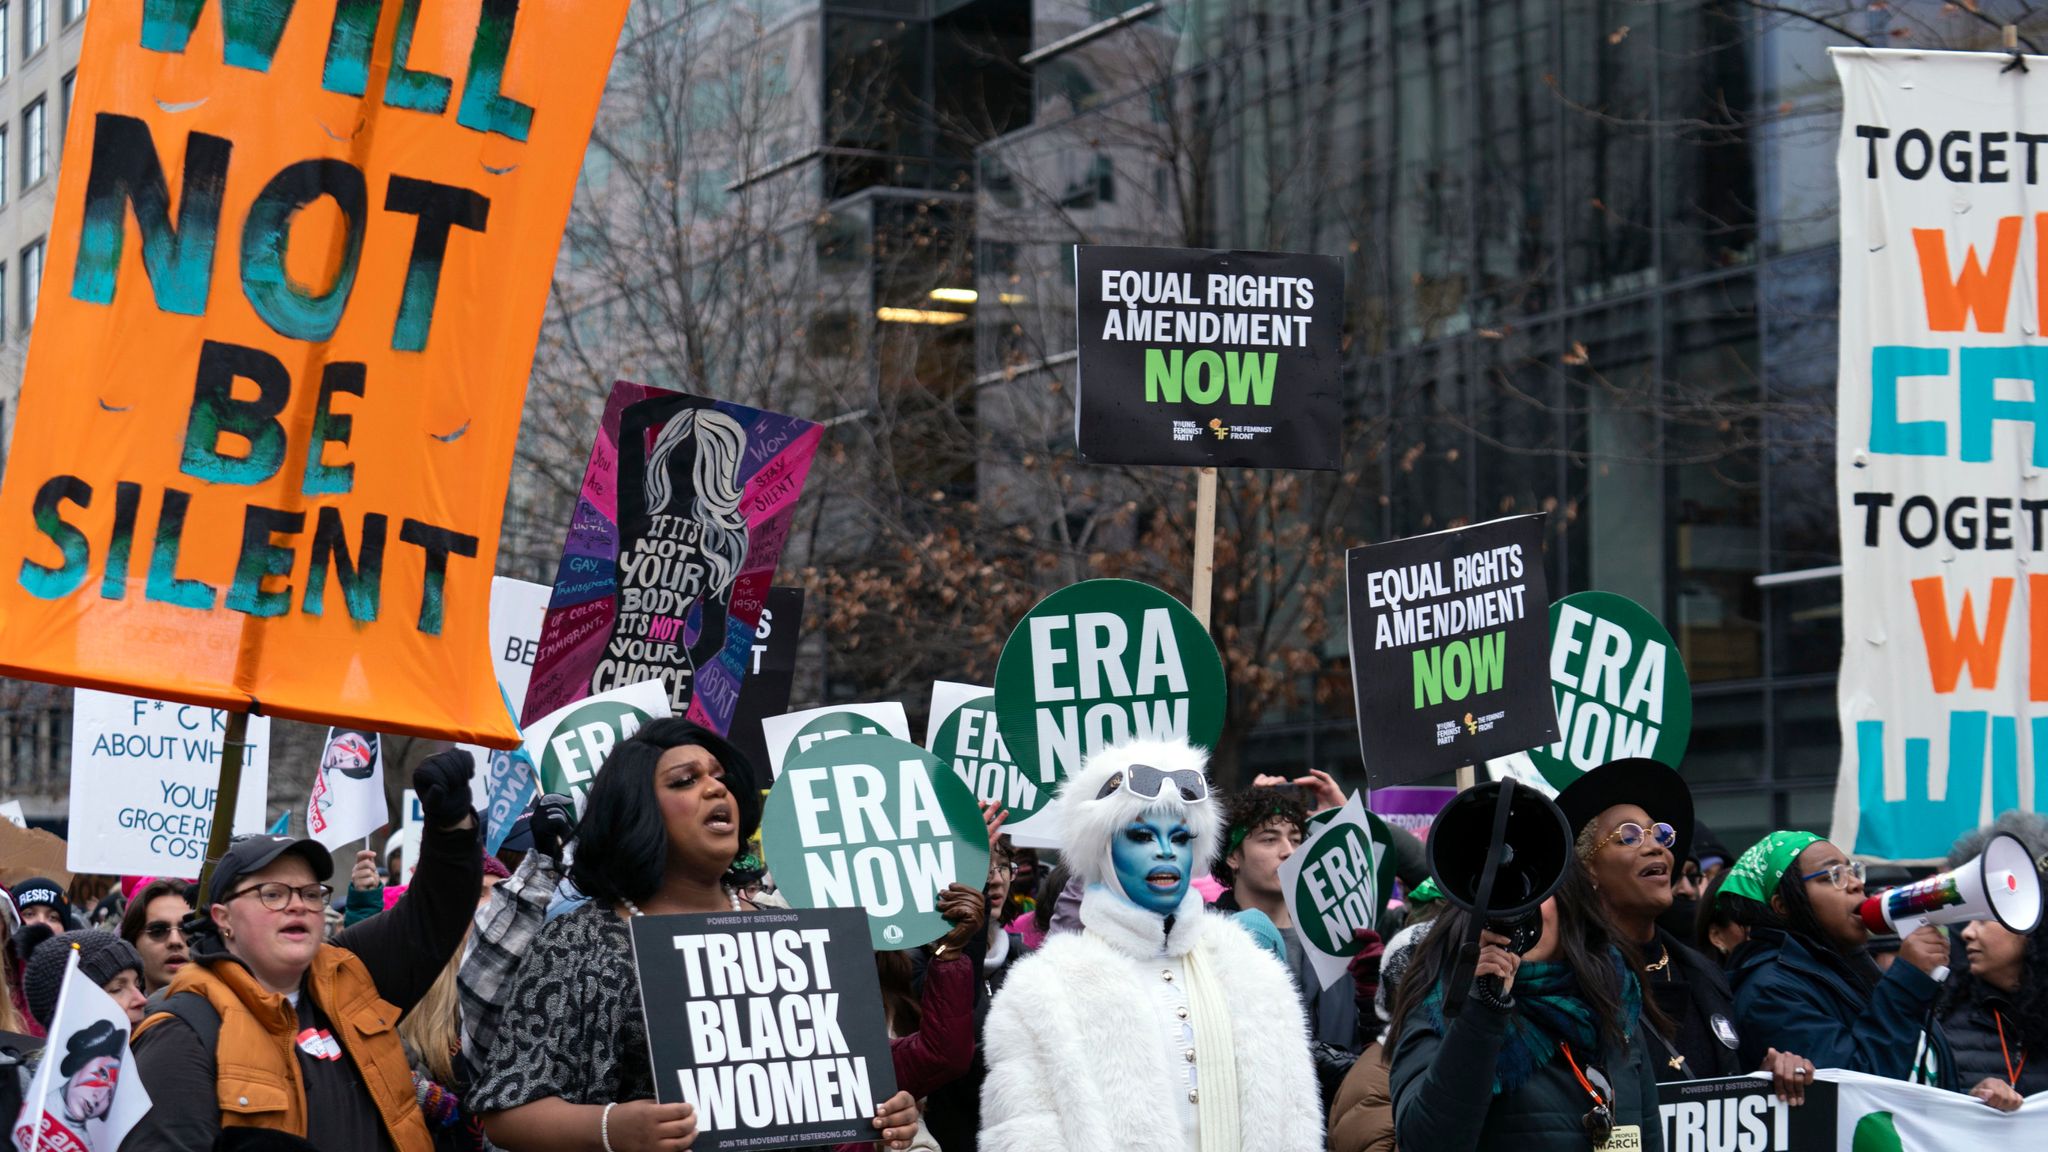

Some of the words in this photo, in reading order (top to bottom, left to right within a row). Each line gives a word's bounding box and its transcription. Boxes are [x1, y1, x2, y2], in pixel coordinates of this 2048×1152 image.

[1856, 125, 2048, 185] TOGET
[70, 112, 490, 352] NOT
[1102, 270, 1200, 309] EQUAL
[1207, 273, 1314, 310] RIGHTS
[1911, 211, 2048, 337] W
[1102, 308, 1312, 347] AMENDMENT
[1145, 348, 1279, 405] NOW
[180, 339, 367, 496] BE
[750, 417, 799, 463] WON'T
[1173, 427, 1203, 435] FEMINIST
[1230, 425, 1243, 433] THE
[755, 472, 795, 512] SILENT
[574, 523, 608, 533] UNTIL
[648, 514, 669, 538] IF
[669, 516, 700, 544] IT'S
[1854, 492, 2048, 551] TOGET
[18, 474, 479, 636] SILENT
[620, 551, 704, 595] YOUR
[635, 538, 696, 562] NOT
[1367, 561, 1450, 611] EQUAL
[1453, 544, 1524, 592] RIGHTS
[551, 611, 567, 628] OF
[617, 613, 649, 636] IT'S
[648, 615, 684, 641] NOT
[621, 588, 694, 617] BODY
[1374, 584, 1526, 650] AMENDMENT
[609, 637, 686, 664] YOUR
[1029, 608, 1188, 702] ERA
[1551, 603, 1667, 724] ERA
[1911, 573, 2048, 702] W
[699, 664, 739, 719] ABORT
[1412, 631, 1506, 710] NOW
[92, 733, 178, 759] ABOUT
[183, 738, 257, 766] WHT
[956, 708, 1011, 762] ER
[1035, 698, 1189, 784] NOW
[1437, 735, 1455, 746] PARTY
[1533, 686, 1660, 772] NOW
[788, 759, 951, 848] ERA
[953, 758, 1038, 811] NOW
[1854, 711, 2048, 860] WI
[19, 889, 57, 907] RESIST
[805, 841, 957, 917] NOW
[1302, 829, 1368, 913] ERA
[706, 916, 741, 926] POWERED
[753, 913, 799, 923] SISTERSONG
[673, 929, 831, 998] TRUST
[685, 992, 850, 1064] BLACK
[1681, 1084, 1714, 1095] POWERED
[1714, 1082, 1725, 1092] BY
[1725, 1080, 1768, 1092] SISTERSONG
[719, 1139, 735, 1148] JOIN
[736, 1138, 749, 1147] THE
[750, 1135, 789, 1145] MOVEMENT
[790, 1134, 800, 1142] AT
[800, 1129, 857, 1141] SISTERSONG.ORG
[1659, 1094, 1789, 1152] TRUST
